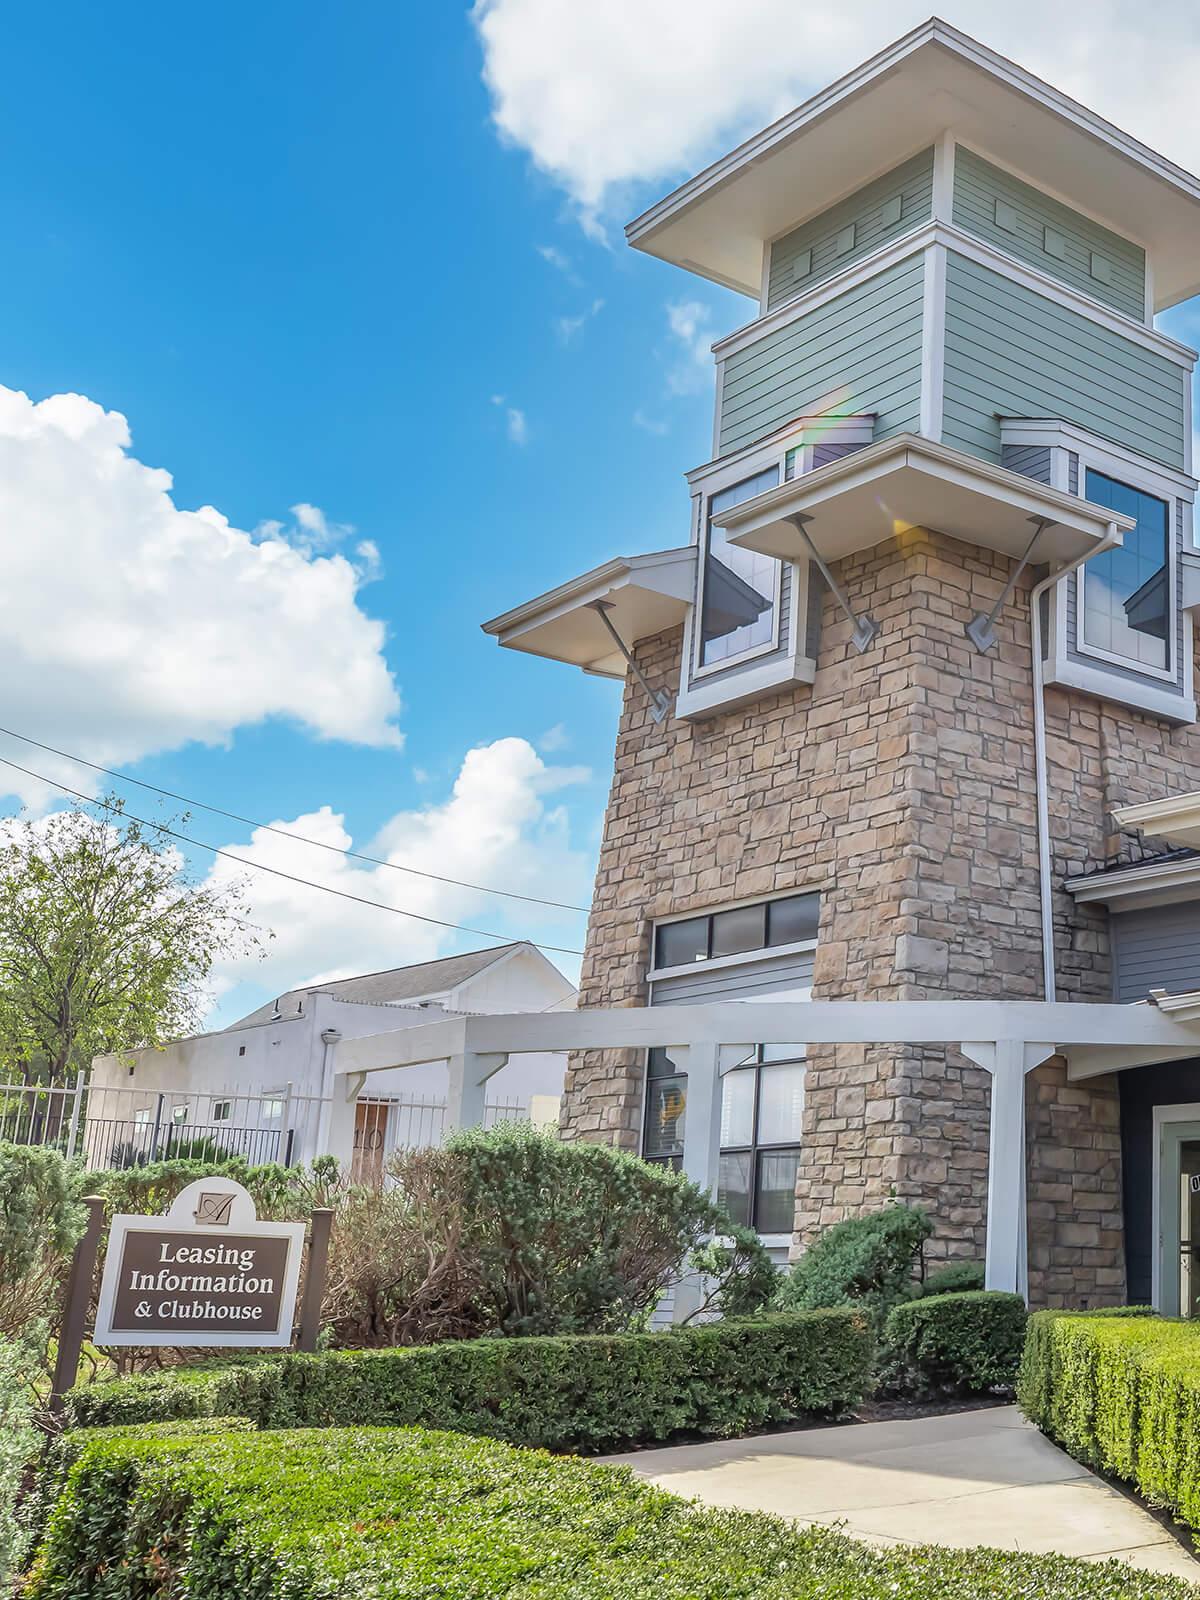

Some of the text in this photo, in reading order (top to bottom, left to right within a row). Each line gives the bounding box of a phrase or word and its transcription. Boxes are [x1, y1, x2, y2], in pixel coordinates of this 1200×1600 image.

[159, 1243, 256, 1270] Leasing
[129, 1269, 274, 1294] Information
[134, 1300, 262, 1320] & Clubhouse
